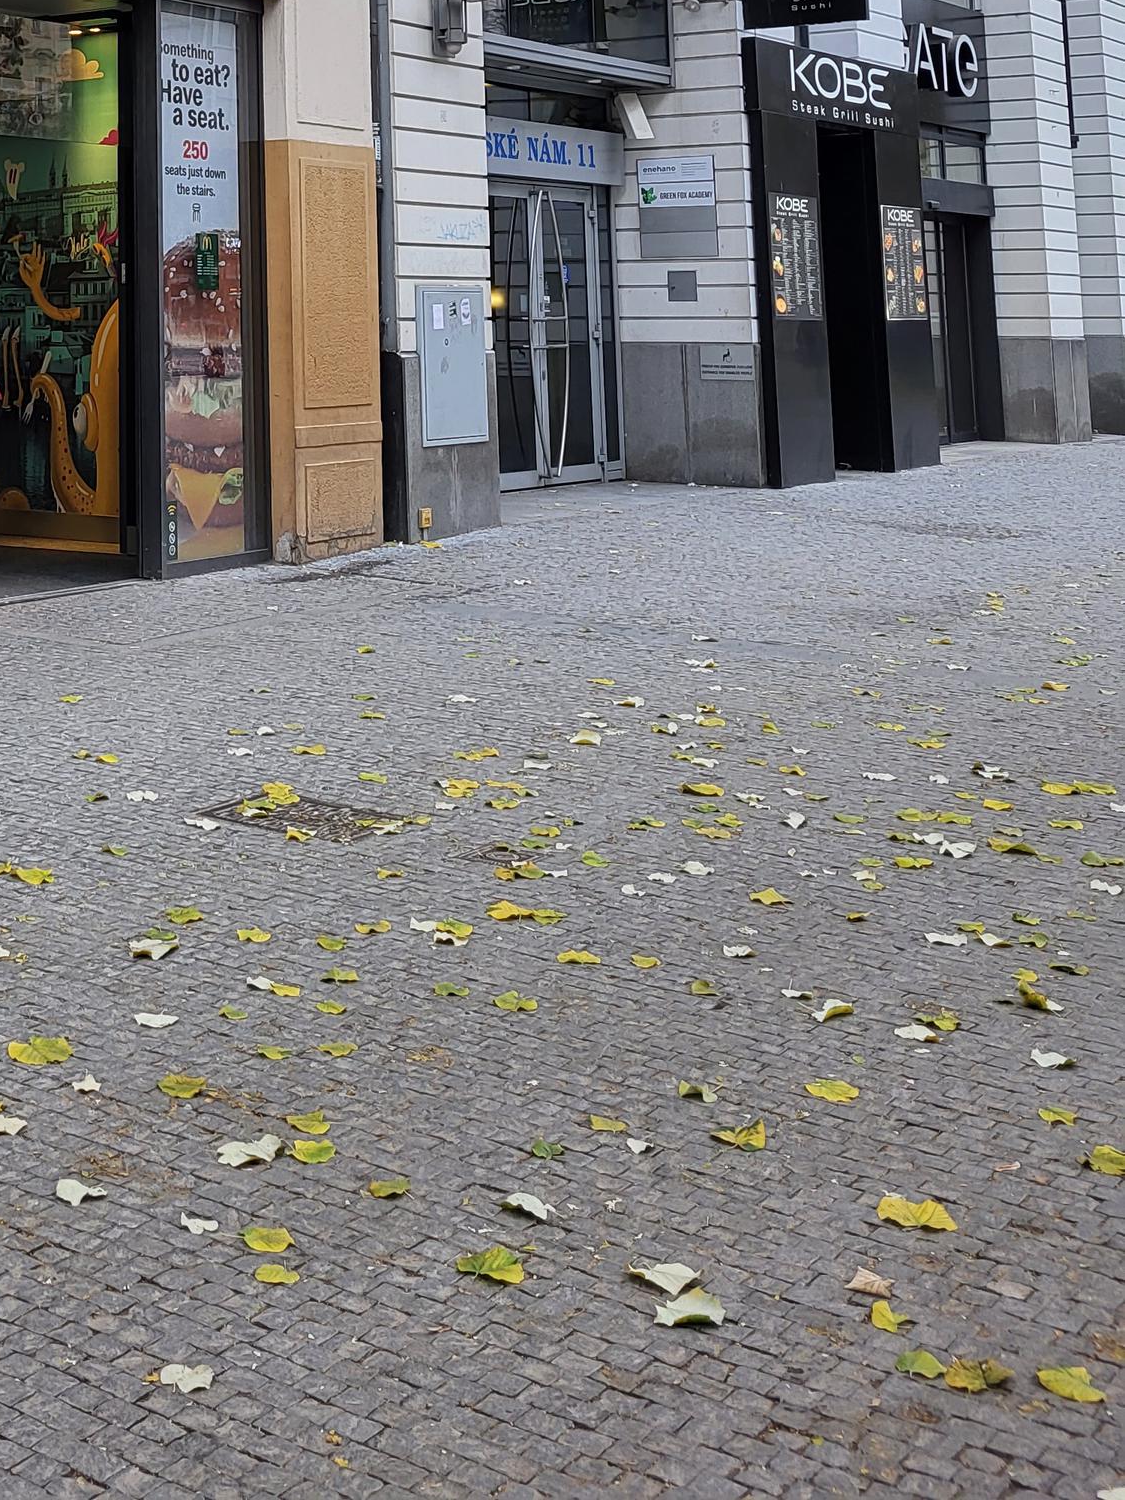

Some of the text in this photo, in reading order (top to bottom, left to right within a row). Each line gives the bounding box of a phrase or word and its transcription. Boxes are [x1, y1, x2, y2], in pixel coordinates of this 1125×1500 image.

[171, 58, 231, 88] to eat?
[789, 49, 892, 111] KOBE
[161, 78, 204, 107] Have
[173, 107, 230, 131] a seat.
[792, 99, 895, 129] Steak Grill Sushi
[183, 139, 209, 161] 250
[527, 132, 572, 166] NÁM.
[578, 143, 597, 169] 11
[164, 164, 227, 181] seats just down
[642, 164, 677, 174] enehano
[177, 183, 216, 198] the stairs.
[660, 190, 713, 200] GREEN FOX ACADEMY
[776, 196, 809, 213] KOBE
[887, 208, 914, 223] KOBE
